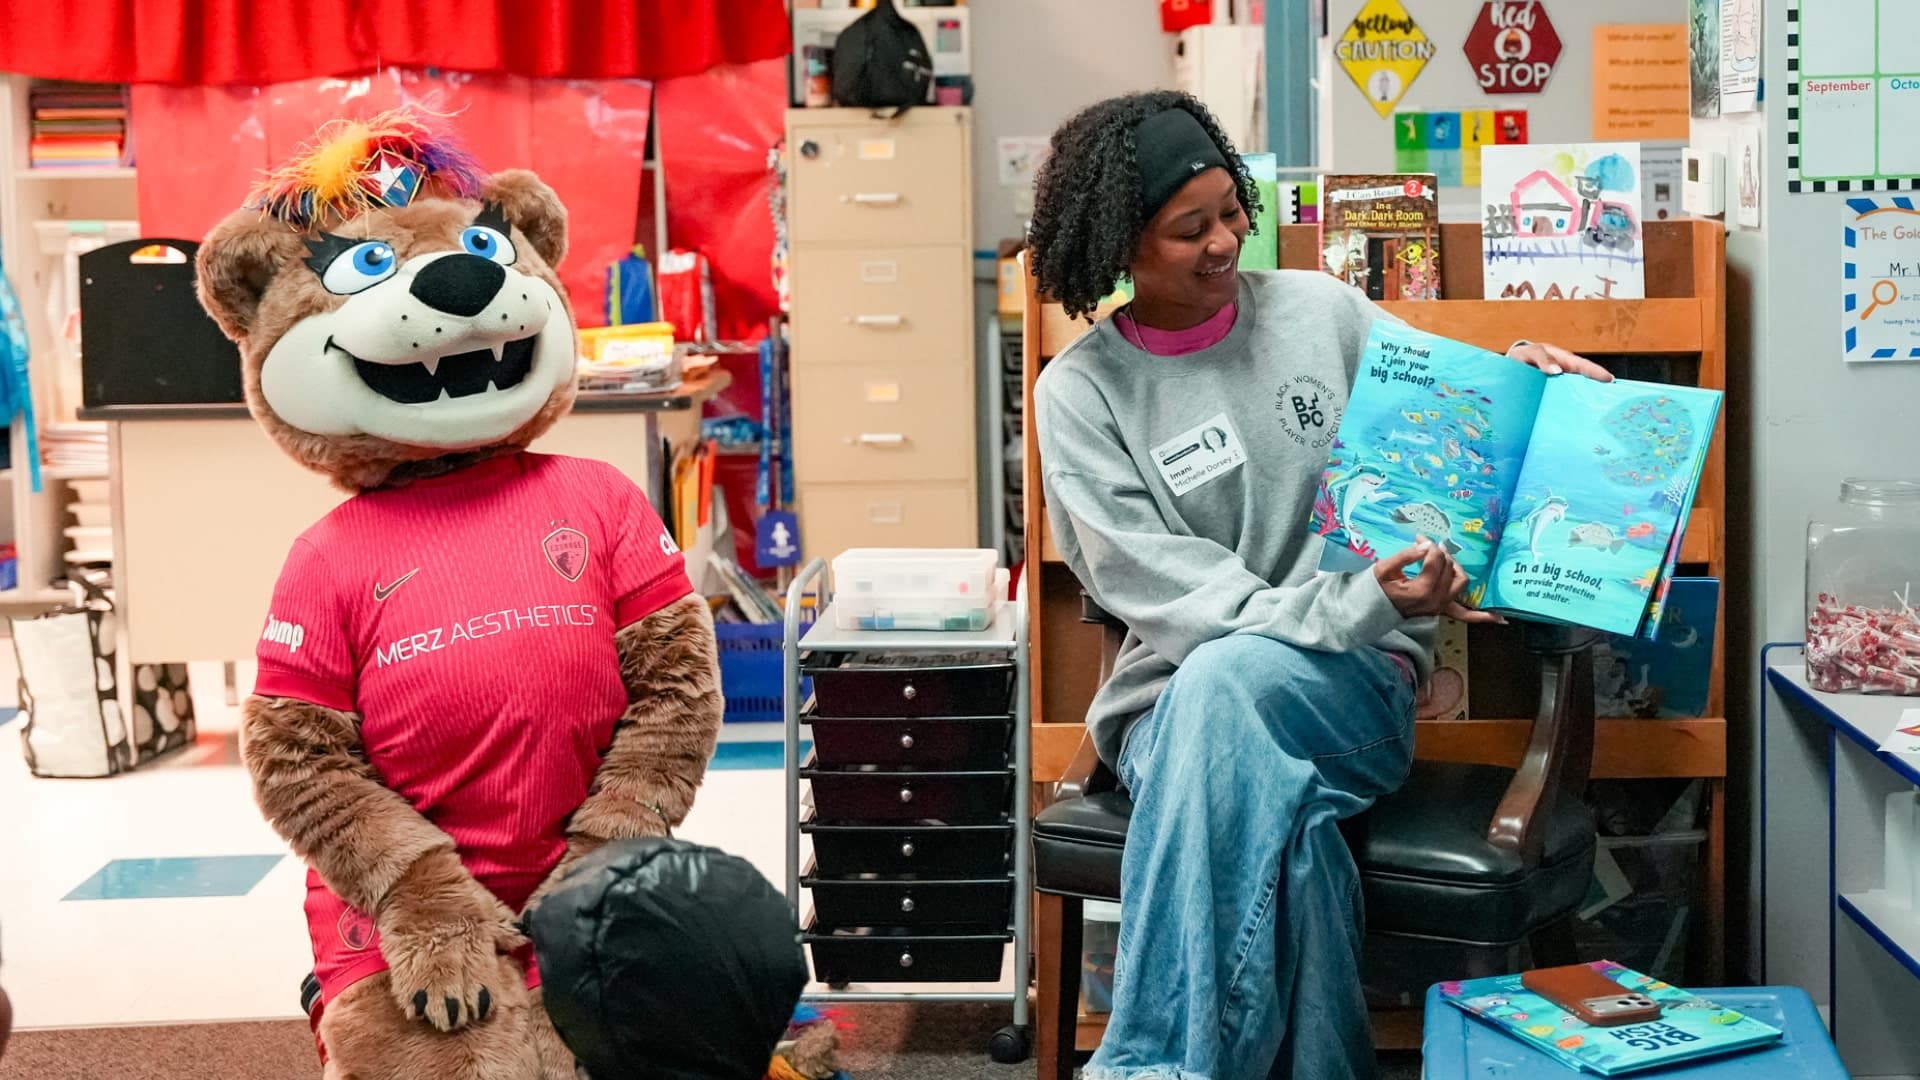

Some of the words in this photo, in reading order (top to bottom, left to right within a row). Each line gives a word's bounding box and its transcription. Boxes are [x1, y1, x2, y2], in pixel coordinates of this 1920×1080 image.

[1490, 0, 1536, 30] Red
[1353, 14, 1416, 38] yellow
[1335, 39, 1434, 61] CAUTION
[1479, 62, 1550, 88] STOP
[1807, 80, 1871, 95] September
[1410, 183, 1417, 194] 2
[1371, 210, 1394, 221] Dark
[1395, 210, 1424, 220] Room
[1376, 202, 1385, 210] In
[1860, 226, 1887, 241] The
[1381, 341, 1400, 356] Why
[1403, 346, 1431, 359] should
[1381, 354, 1386, 363] I
[1387, 355, 1406, 368] join
[1409, 361, 1430, 372] your
[1370, 366, 1389, 384] big
[1392, 370, 1436, 389] school?
[1279, 417, 1306, 447] PLAYER
[1311, 406, 1342, 449] COLLECTIVE
[1169, 464, 1193, 481] Imani
[1174, 469, 1206, 489] Michelle
[1206, 456, 1232, 473] Dorsey
[1514, 562, 1527, 574] In
[1531, 563, 1539, 573] a
[1543, 562, 1561, 580] big
[1525, 578, 1553, 588] provide
[1555, 582, 1596, 601] protection
[1526, 590, 1540, 598] and
[1542, 591, 1571, 605] shelter.
[376, 627, 445, 668] MERZ
[1608, 1021, 1677, 1040] FISH
[1626, 1029, 1701, 1051] BIG
